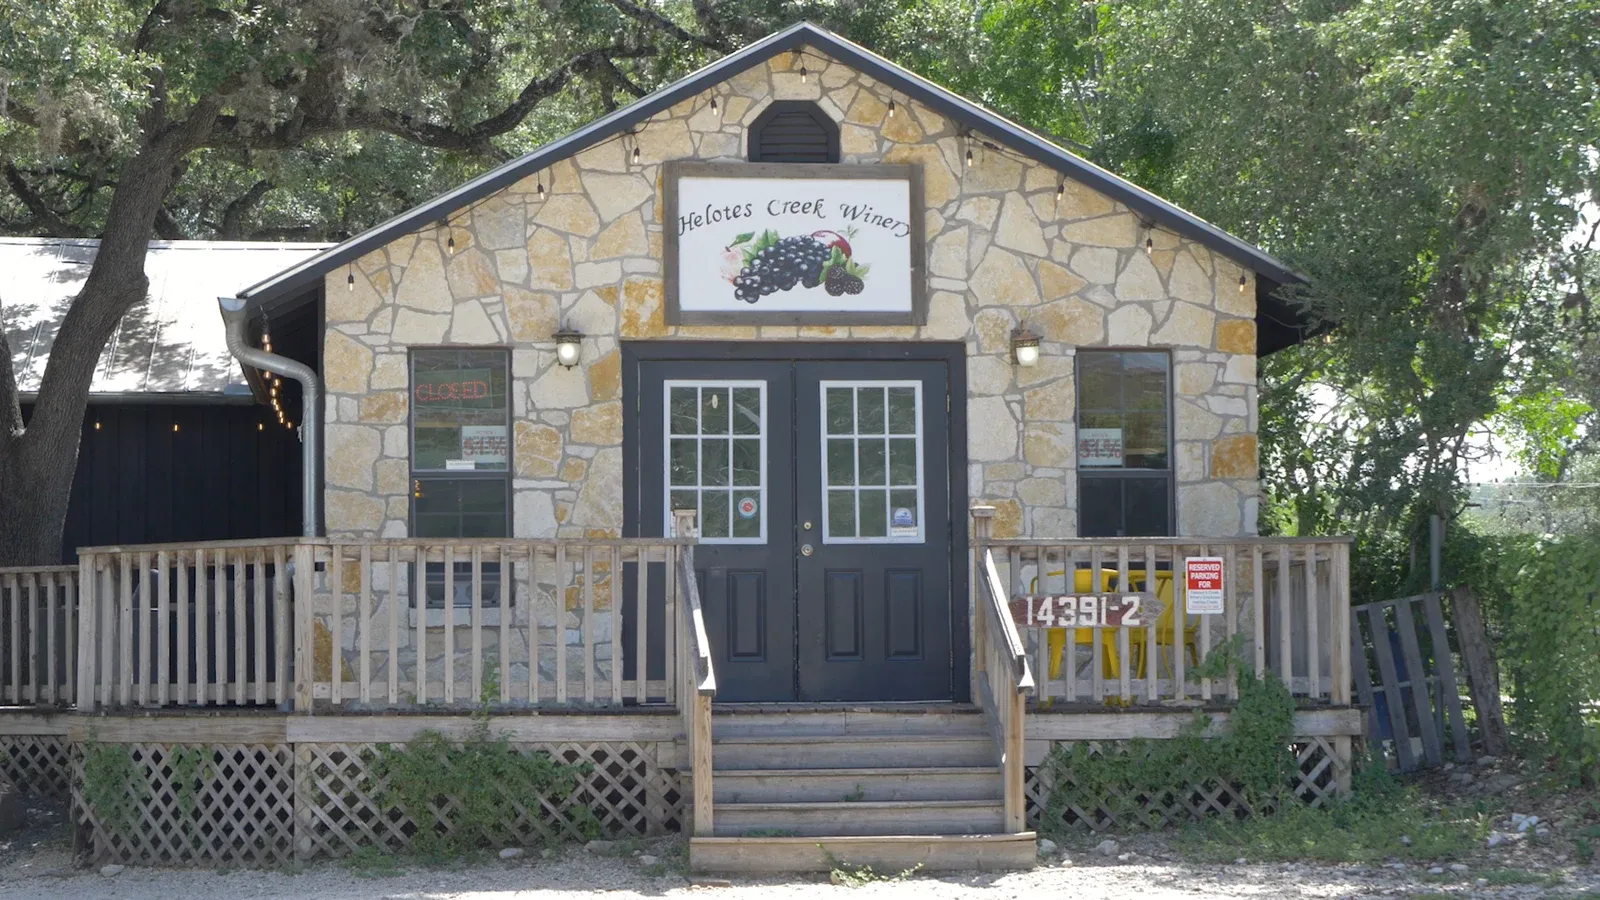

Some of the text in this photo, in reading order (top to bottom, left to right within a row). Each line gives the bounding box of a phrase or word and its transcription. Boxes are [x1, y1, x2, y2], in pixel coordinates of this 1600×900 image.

[679, 198, 912, 238] Helotes Creek Winery
[416, 381, 489, 401] CLOSED
[1188, 563, 1220, 571] RESERVED
[1190, 572, 1219, 580] PARKING
[1198, 580, 1211, 588] FOR
[1026, 596, 1140, 626] 14391-2
